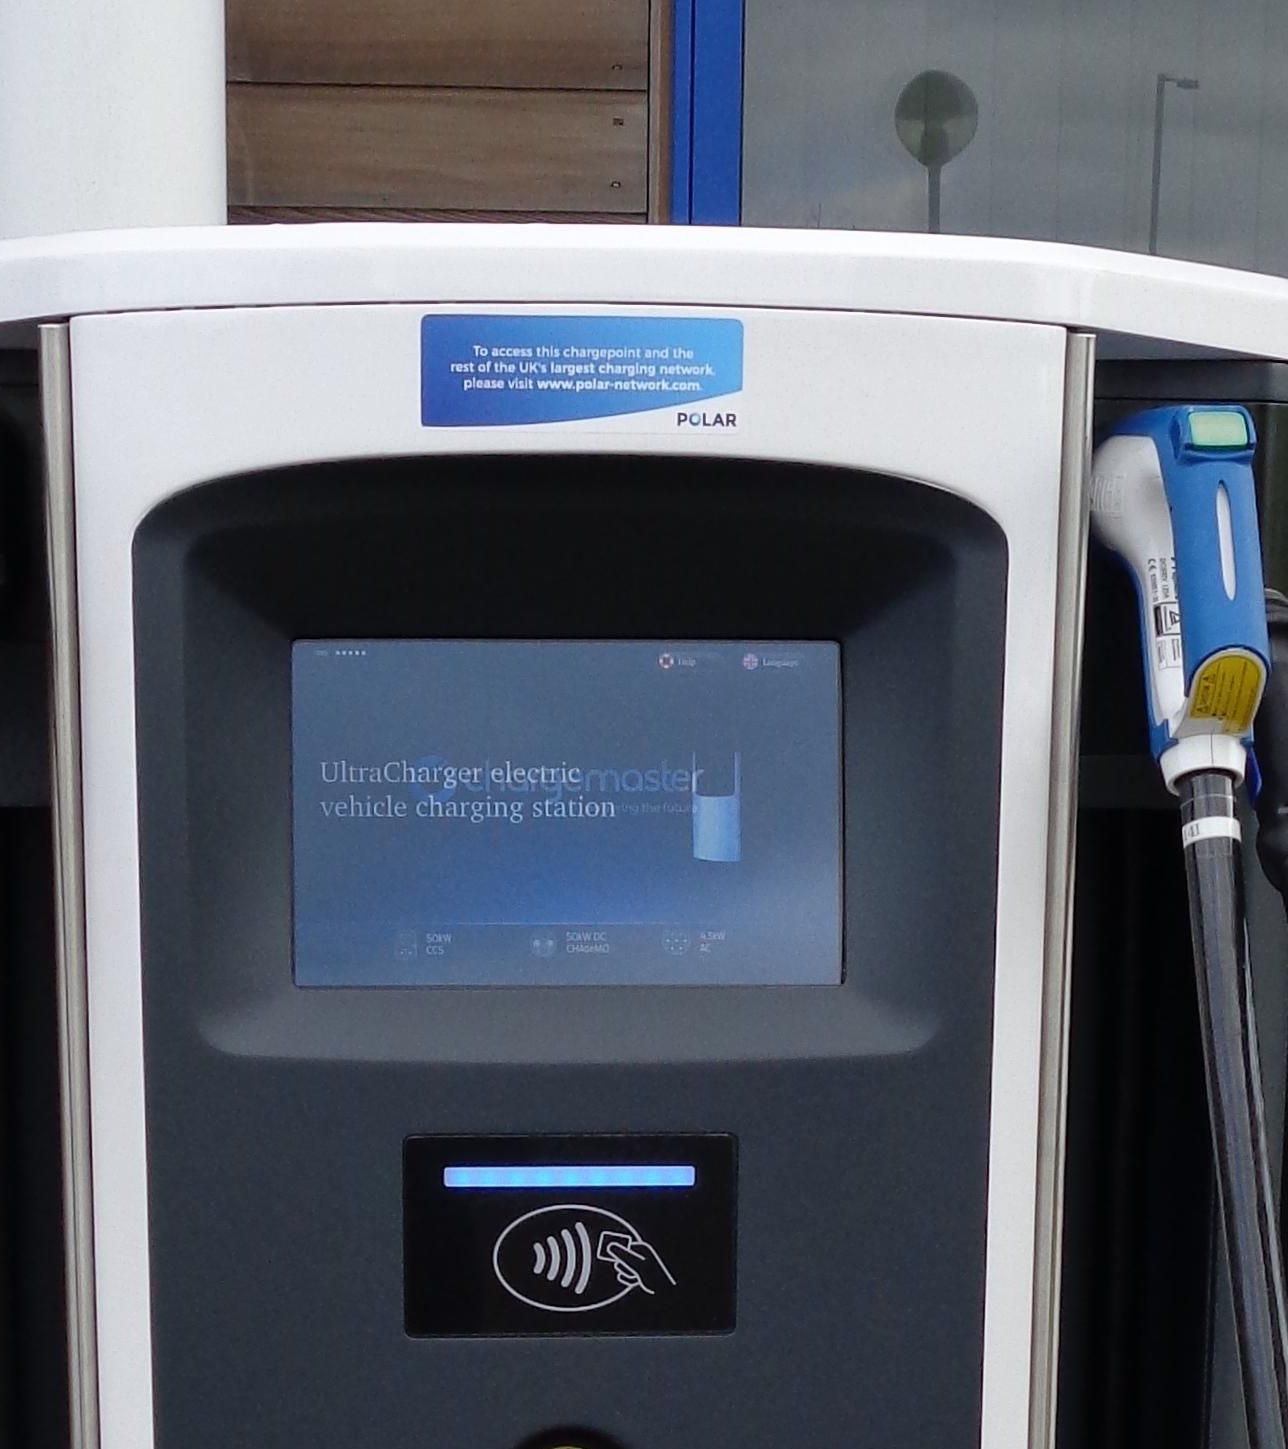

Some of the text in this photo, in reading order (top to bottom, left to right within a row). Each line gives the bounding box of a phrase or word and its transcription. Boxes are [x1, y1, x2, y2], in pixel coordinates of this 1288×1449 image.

[473, 345, 694, 360] To access this chargepoint and the
[450, 362, 474, 373] rest
[478, 361, 491, 373] of
[494, 362, 516, 373] the
[519, 362, 547, 373] UK's
[551, 362, 595, 376] largest
[598, 363, 656, 376] charging
[463, 378, 505, 391] please
[508, 378, 533, 389] visit
[676, 412, 737, 427] POLAR
[320, 760, 581, 789] UltraCharger electric
[320, 795, 408, 818] vehicle
[415, 795, 524, 824] charging
[532, 795, 616, 818] station
